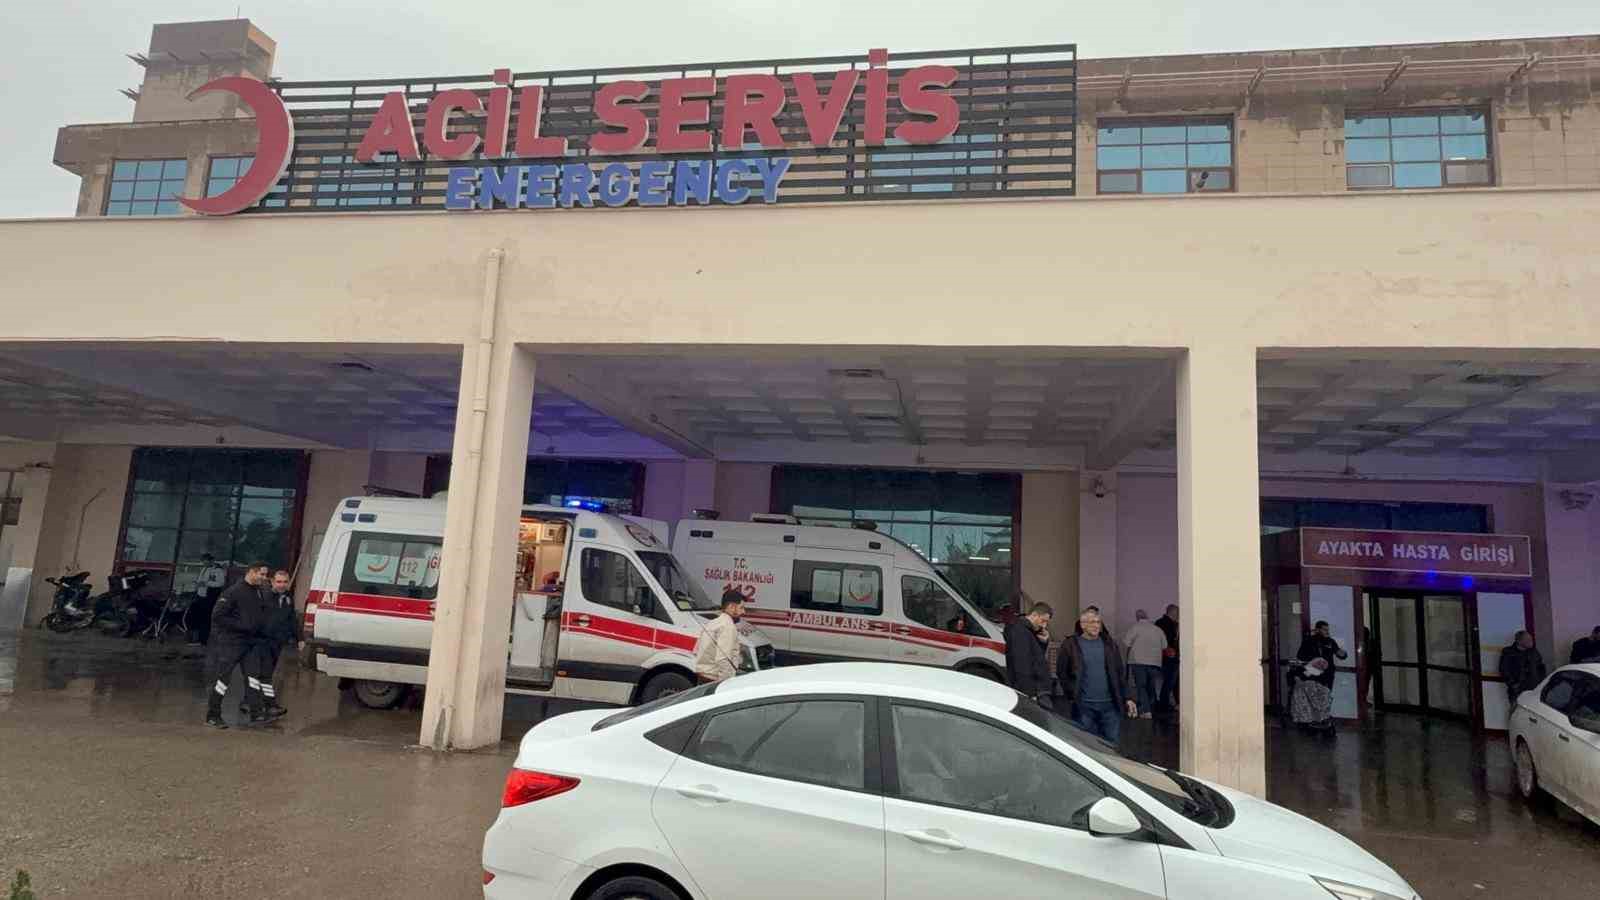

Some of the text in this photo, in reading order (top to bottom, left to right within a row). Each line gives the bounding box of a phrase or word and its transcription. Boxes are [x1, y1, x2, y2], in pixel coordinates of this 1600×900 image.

[355, 48, 960, 163] ACİL SERVİS
[445, 157, 791, 211] EMERGENCY
[1317, 540, 1515, 567] AYAKTA HASTA GİRİŞİ
[792, 612, 870, 630] AMBULANS
